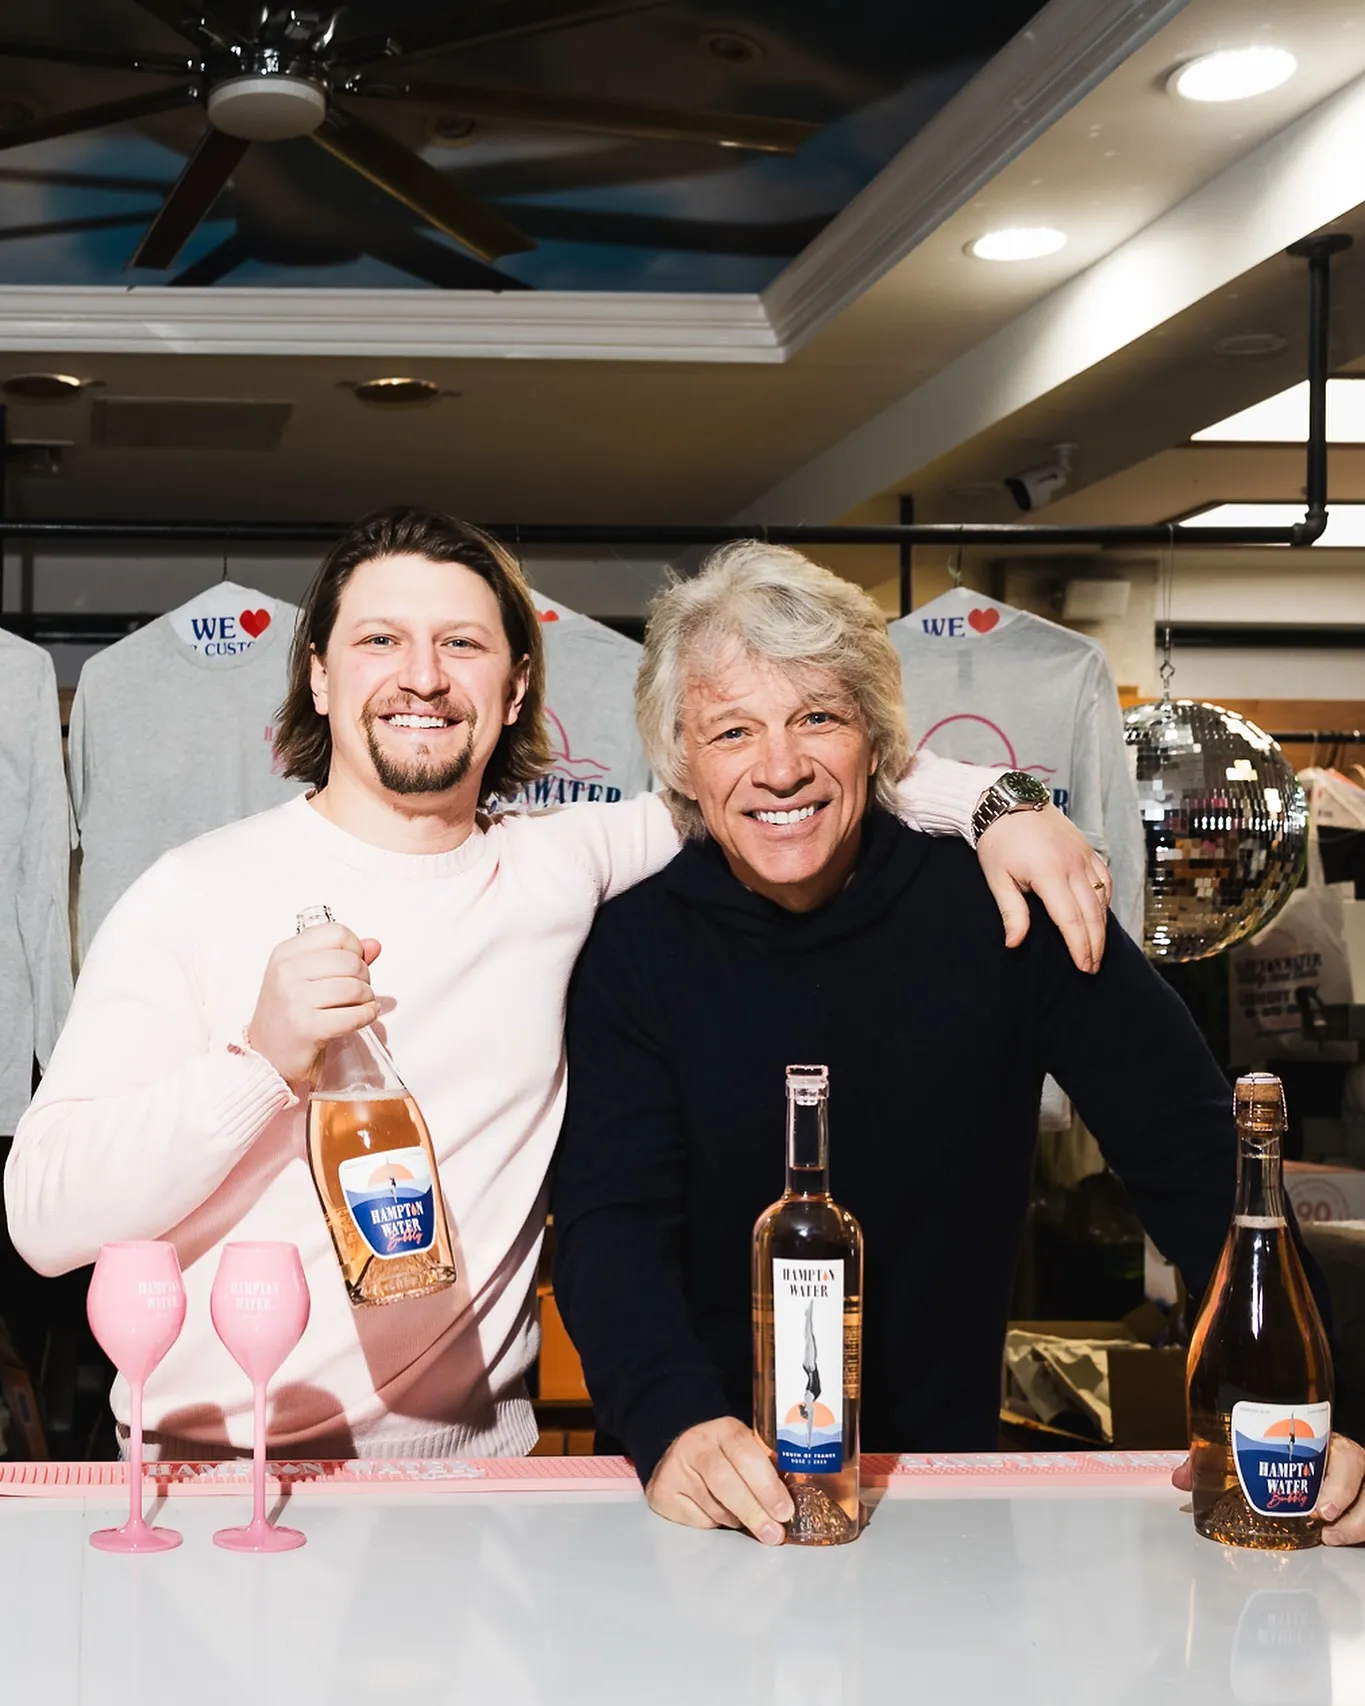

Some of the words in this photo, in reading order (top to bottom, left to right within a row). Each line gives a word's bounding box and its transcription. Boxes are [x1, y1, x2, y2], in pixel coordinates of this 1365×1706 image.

[191, 616, 236, 640] WE
[921, 617, 966, 637] WE
[371, 1201, 424, 1224] HAMPTON
[381, 1218, 421, 1238] WATER
[782, 1268, 835, 1281] HAMPTON
[790, 1284, 829, 1297] WATER
[1259, 1461, 1315, 1477] HAMPTON
[1267, 1479, 1309, 1495] WATER
